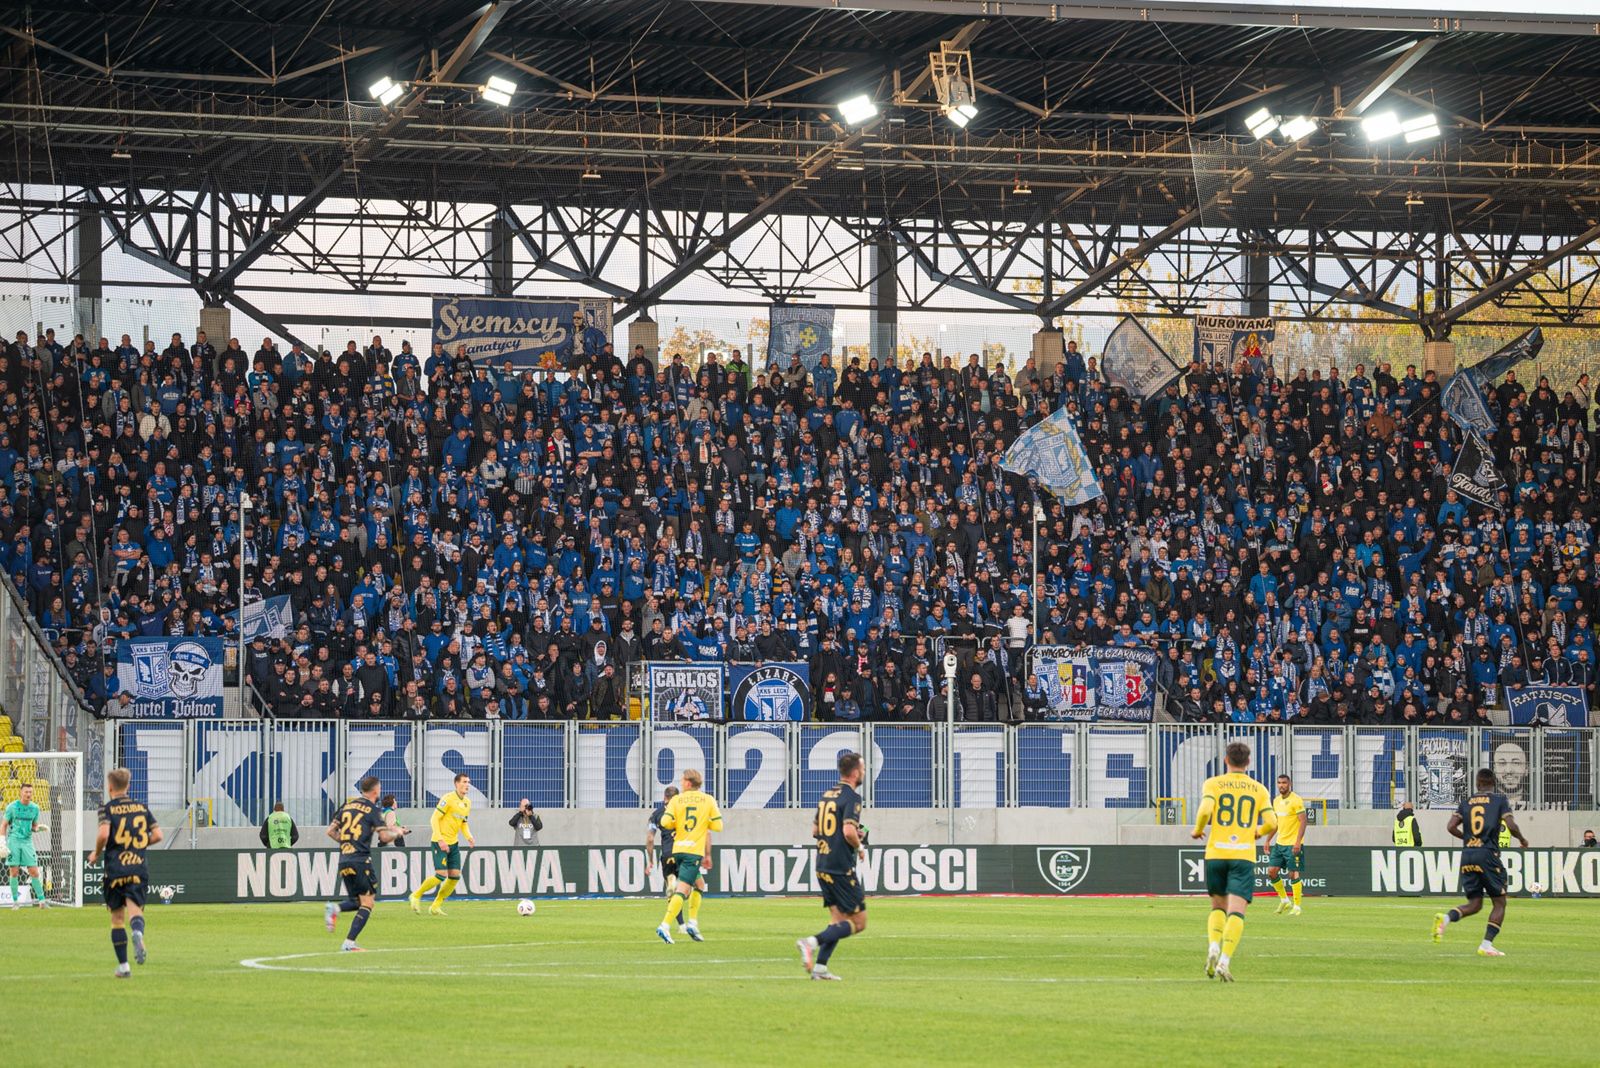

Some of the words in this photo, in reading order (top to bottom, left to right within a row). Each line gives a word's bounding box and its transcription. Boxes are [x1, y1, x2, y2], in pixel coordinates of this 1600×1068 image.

[436, 297, 567, 343] Śremscy
[1197, 316, 1273, 330] MUROWANA
[655, 672, 718, 689] CARLOS
[132, 700, 165, 718] yrtel
[1512, 690, 1582, 707] RATAJSCY
[1218, 781, 1258, 792] SHKURYN
[684, 806, 697, 832] 5
[818, 801, 837, 836] 16
[1167, 808, 1175, 818] 22
[1217, 793, 1256, 828] 80
[1307, 808, 1314, 819] 23
[1470, 805, 1485, 835] 6
[115, 815, 149, 849] 43
[340, 812, 364, 840] 24
[237, 852, 350, 897] NOW
[720, 843, 978, 892] MOŻLWOŚCI
[1371, 850, 1488, 893] NOW
